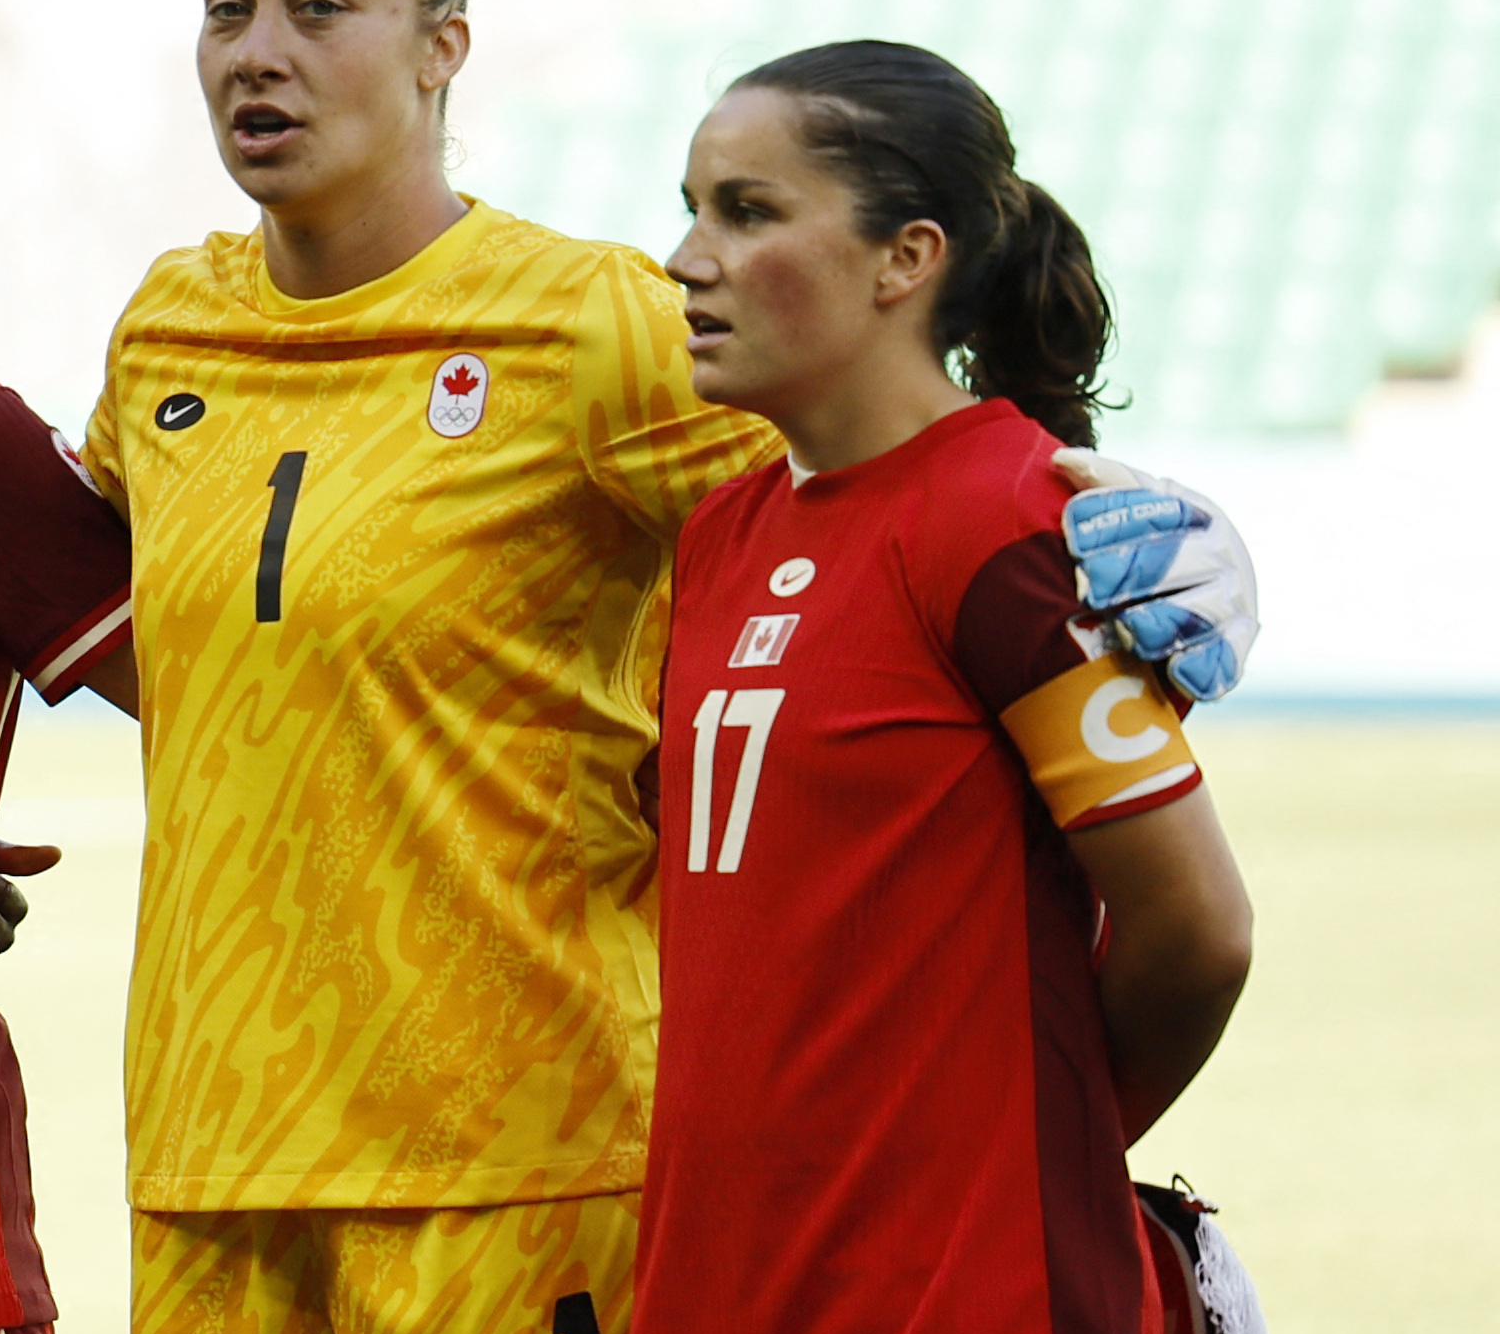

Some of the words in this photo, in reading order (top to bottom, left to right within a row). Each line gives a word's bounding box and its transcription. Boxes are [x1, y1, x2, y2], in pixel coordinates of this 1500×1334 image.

[255, 451, 307, 623] 1
[1078, 506, 1129, 534] WEST
[688, 689, 786, 873] 17
[1082, 676, 1170, 763] C
